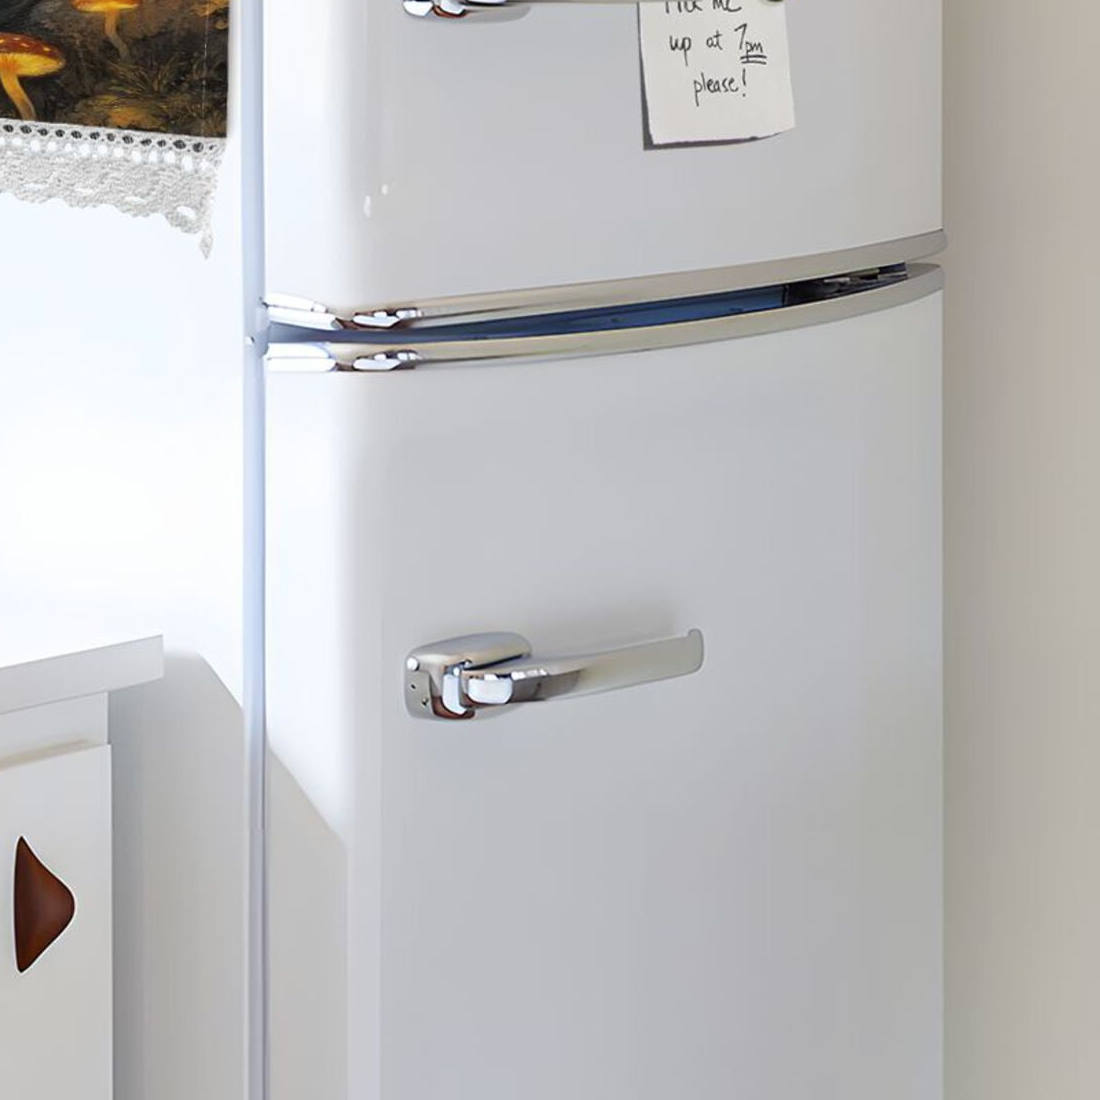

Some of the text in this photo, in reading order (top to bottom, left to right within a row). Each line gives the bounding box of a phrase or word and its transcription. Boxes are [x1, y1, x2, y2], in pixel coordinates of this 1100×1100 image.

[669, 34, 692, 67] up
[706, 30, 723, 51] at
[693, 68, 747, 107] please!
